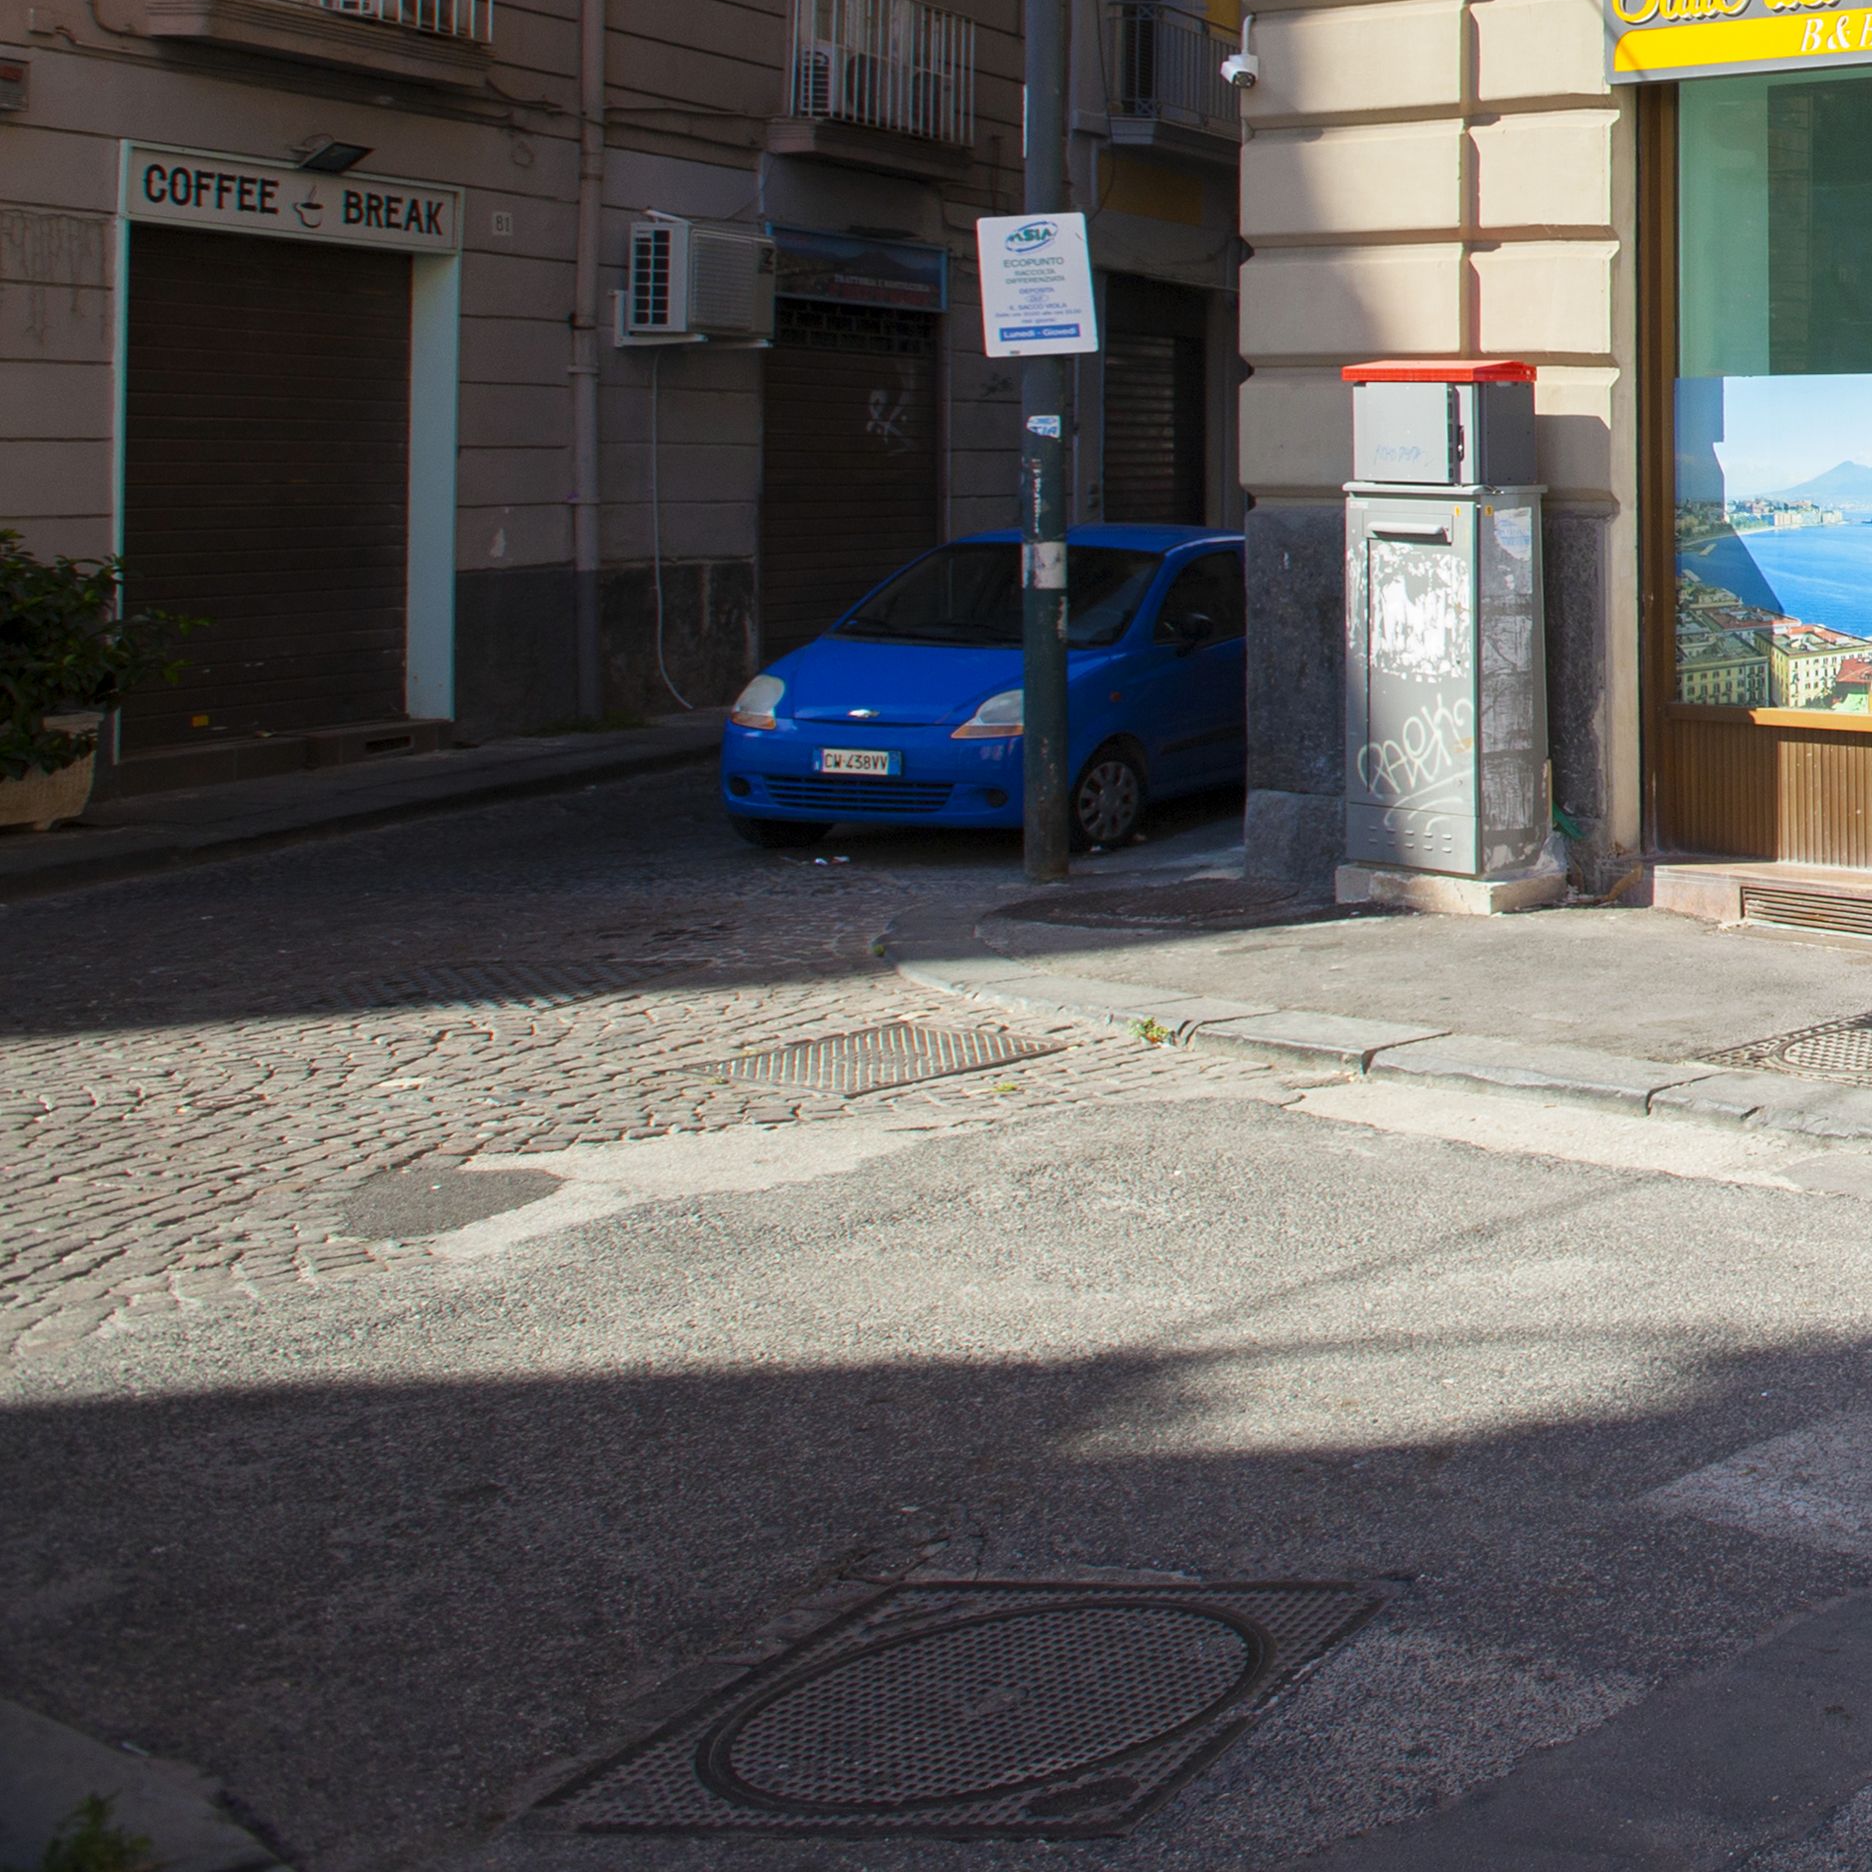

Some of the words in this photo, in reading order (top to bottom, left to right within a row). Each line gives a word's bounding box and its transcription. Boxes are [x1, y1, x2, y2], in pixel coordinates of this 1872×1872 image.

[143, 164, 279, 215] COFFEE
[343, 189, 444, 235] BREAK
[496, 215, 510, 232] 81
[1008, 227, 1053, 242] ASIA
[1002, 257, 1065, 268] ECOPUNTO
[1014, 268, 1057, 277] RACCOLTA
